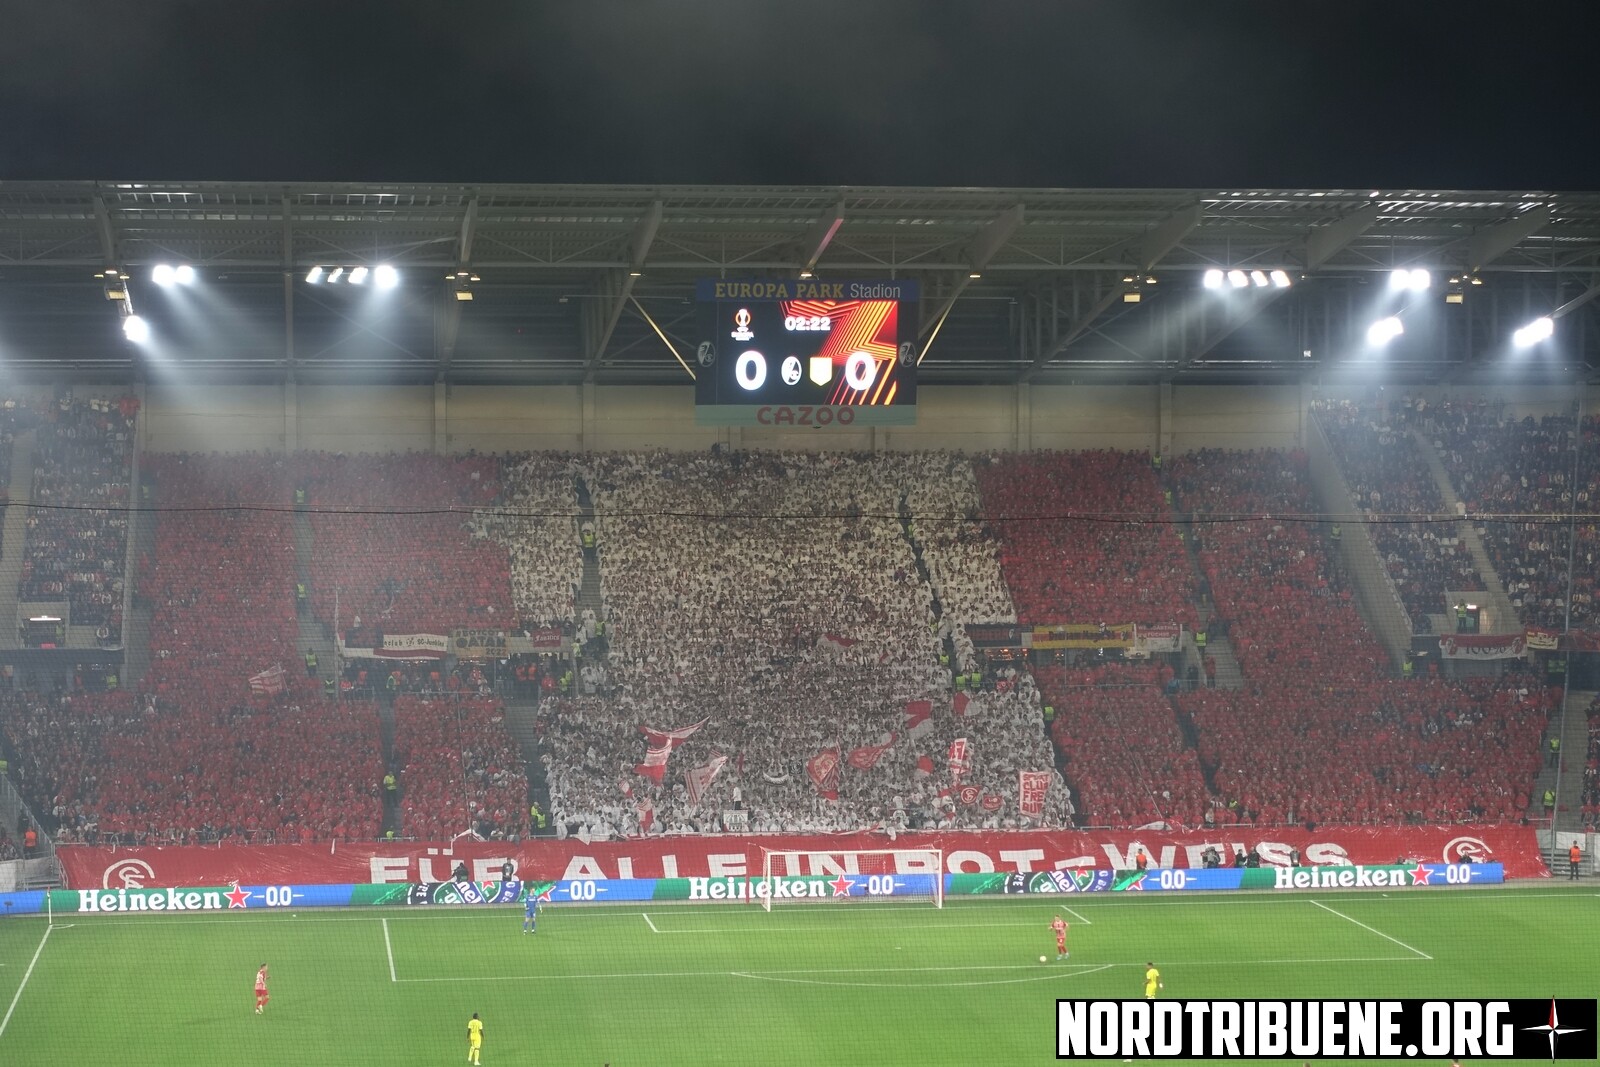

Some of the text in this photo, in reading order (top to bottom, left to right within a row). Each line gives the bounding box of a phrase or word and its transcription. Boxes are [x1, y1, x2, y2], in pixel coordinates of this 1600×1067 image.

[715, 283, 901, 298] EUROPA PARK Stadion
[784, 316, 831, 331] 02:22
[735, 350, 767, 391] 0
[845, 351, 877, 391] 0
[757, 406, 855, 425] CAZOO
[370, 848, 520, 884] FÜR
[1274, 865, 1406, 889] Heineken
[688, 876, 826, 899] Heineken
[78, 888, 222, 912] Heineken
